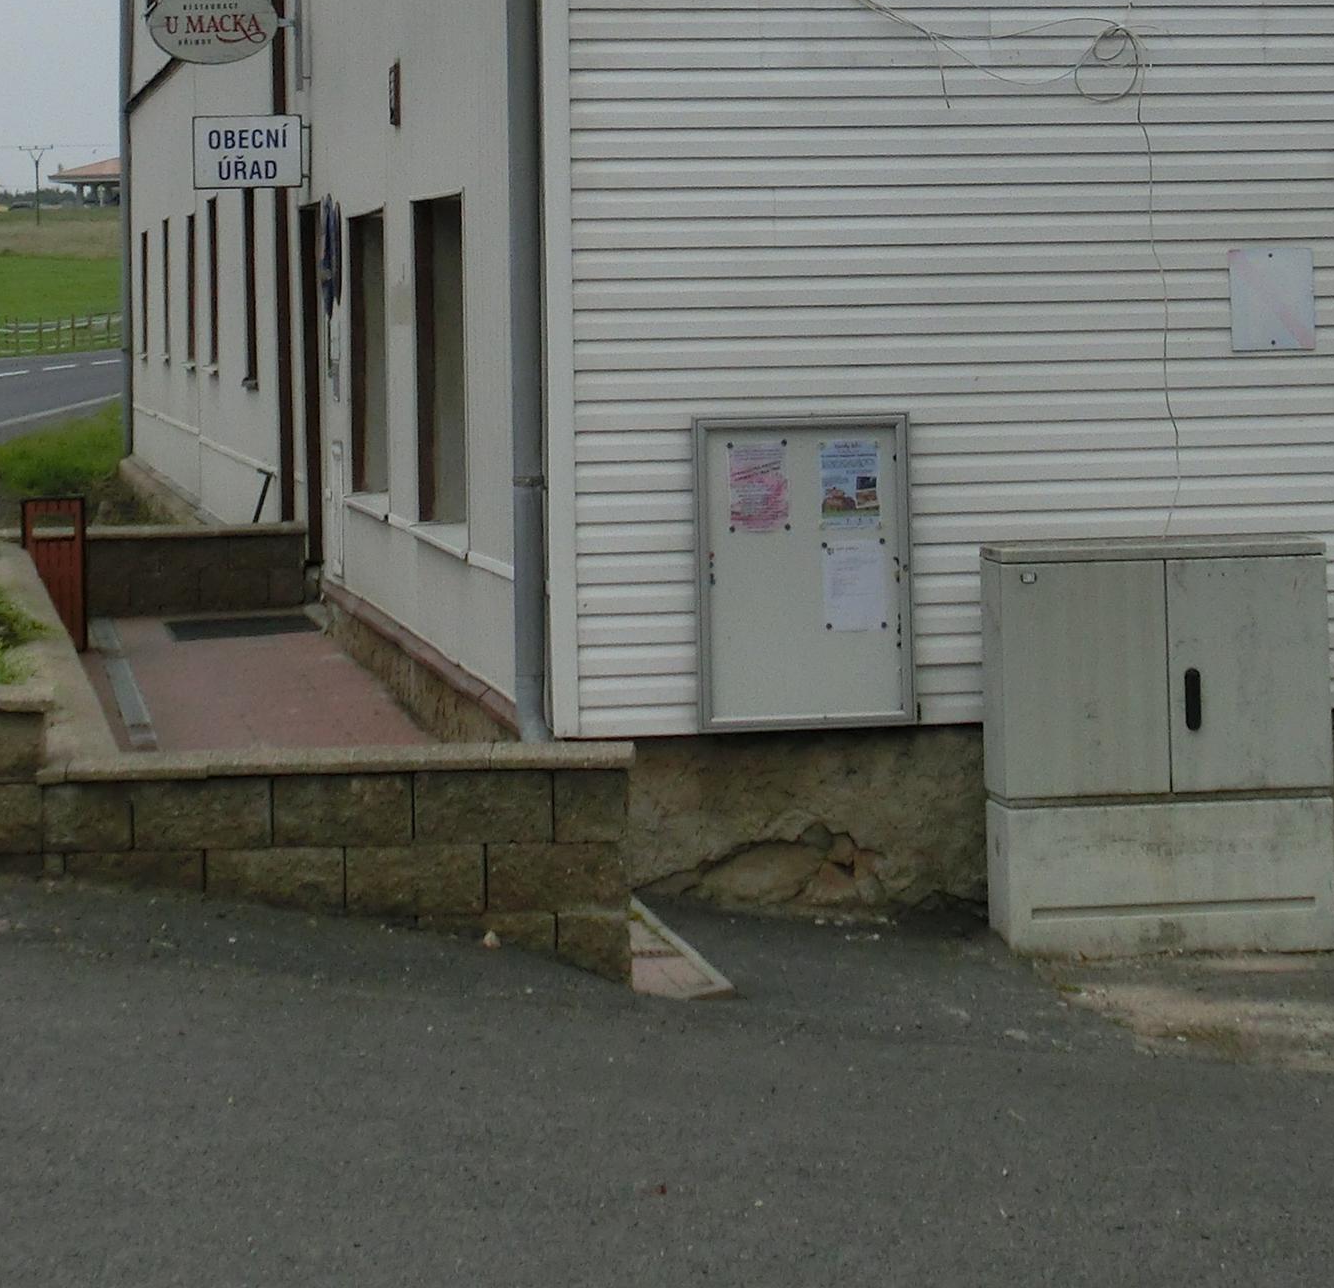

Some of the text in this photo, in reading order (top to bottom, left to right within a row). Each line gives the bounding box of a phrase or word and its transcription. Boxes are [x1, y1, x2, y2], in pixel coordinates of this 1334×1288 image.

[164, 14, 266, 43] U MACKA
[208, 124, 288, 149] OBECNÍ
[218, 155, 277, 180] ÚŘAD
